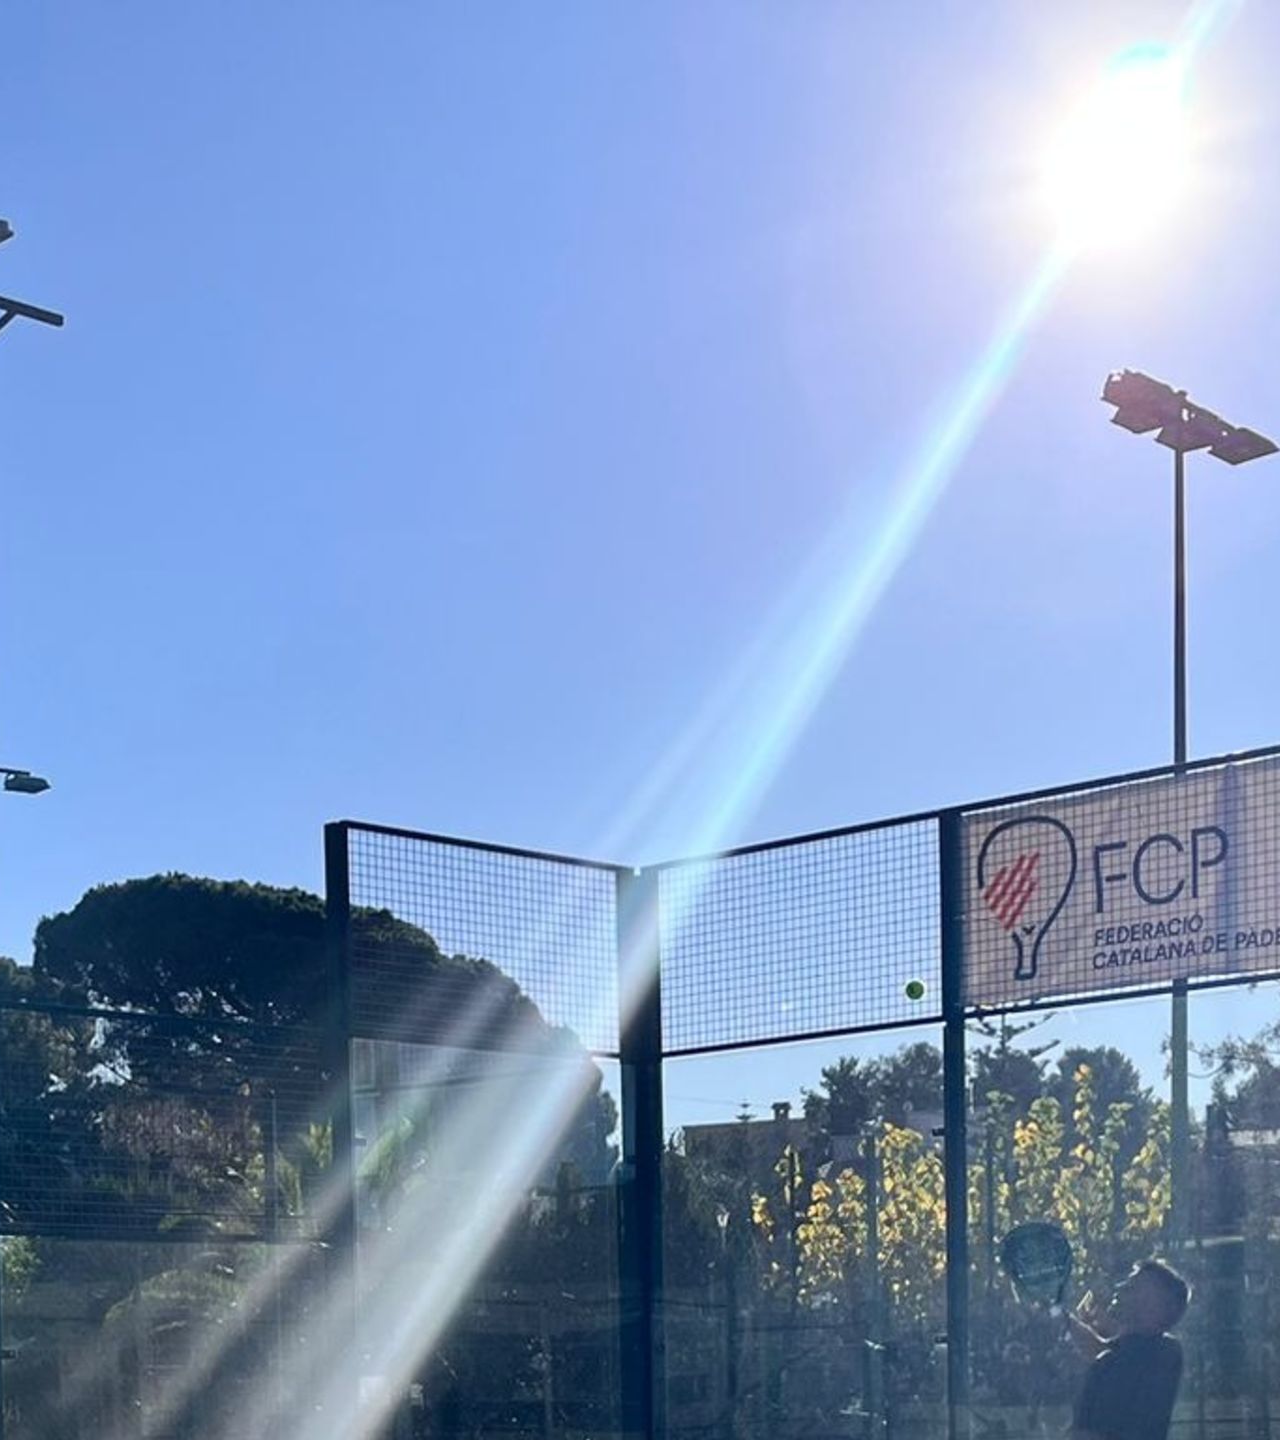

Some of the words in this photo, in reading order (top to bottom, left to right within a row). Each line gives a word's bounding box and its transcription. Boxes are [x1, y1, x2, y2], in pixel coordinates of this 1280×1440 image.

[1094, 825, 1230, 913] FCP
[1093, 911, 1204, 947] FEDERACIÓ
[1092, 939, 1197, 969] CATALANA
[1201, 932, 1228, 953] DE
